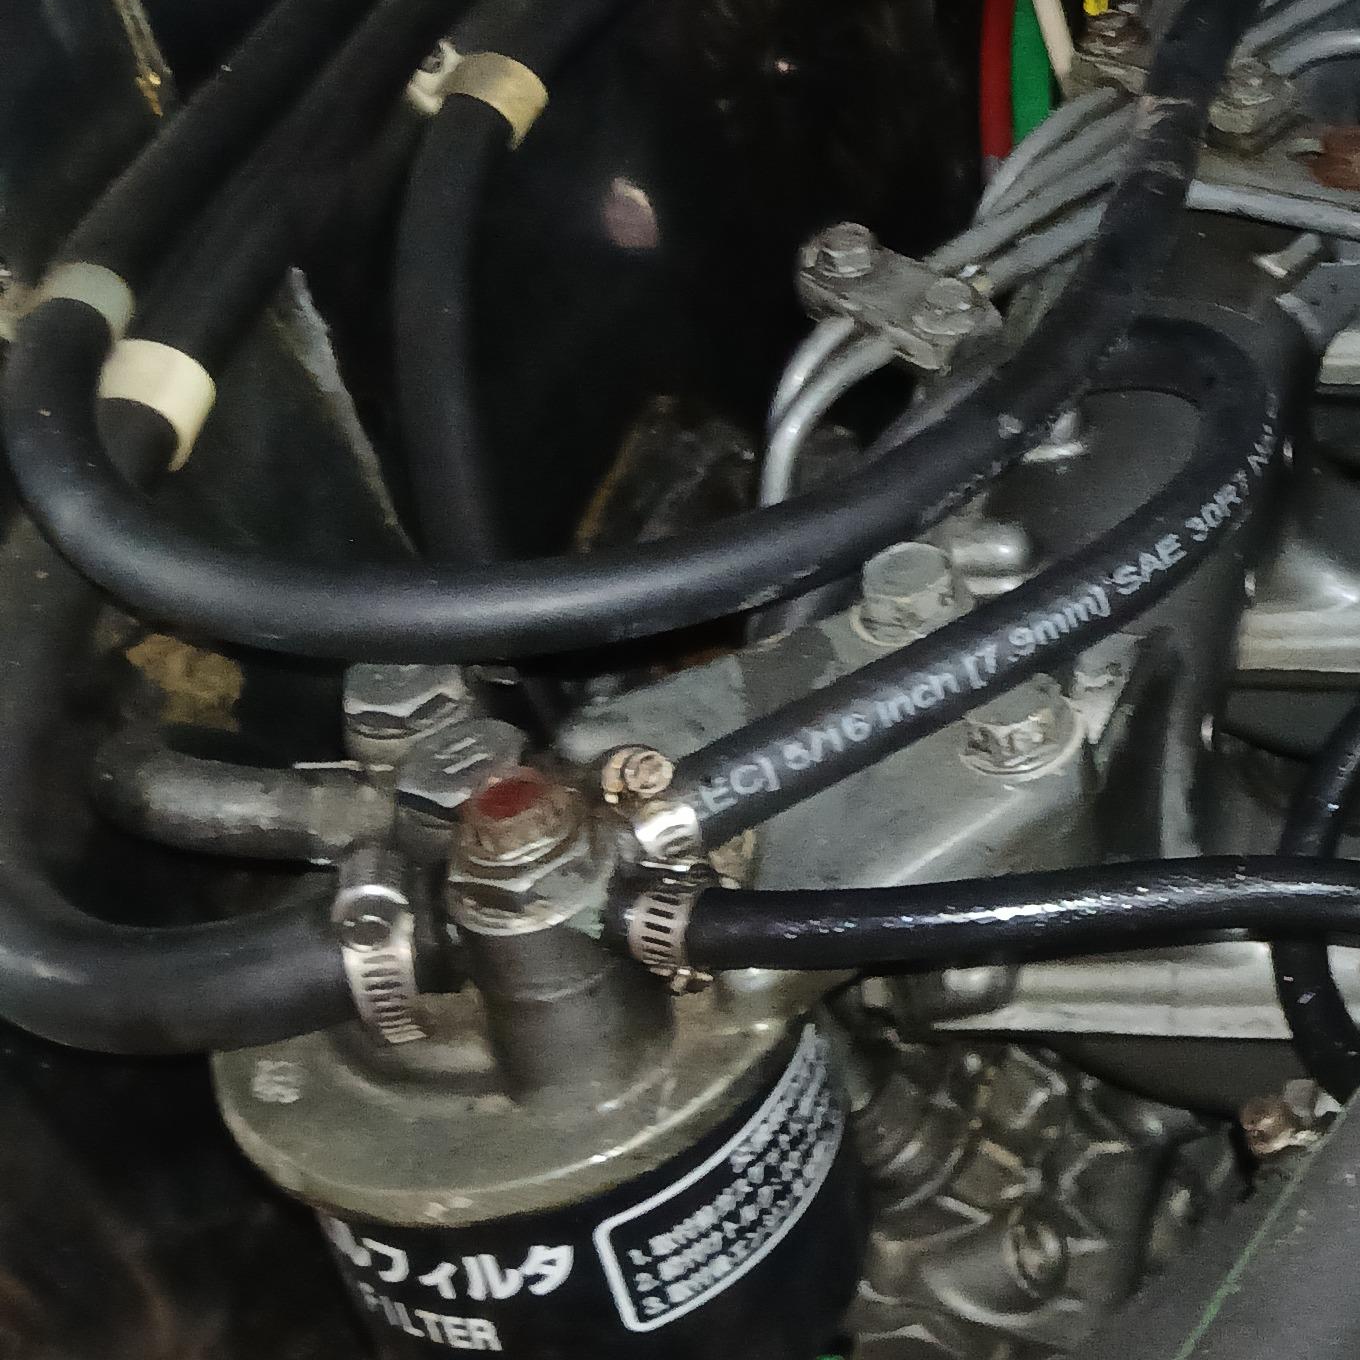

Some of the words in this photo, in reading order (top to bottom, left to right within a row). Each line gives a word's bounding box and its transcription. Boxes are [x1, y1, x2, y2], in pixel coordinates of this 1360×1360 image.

[782, 713, 873, 770] 5/16
[872, 672, 962, 728] inch
[1112, 533, 1187, 596] SAE
